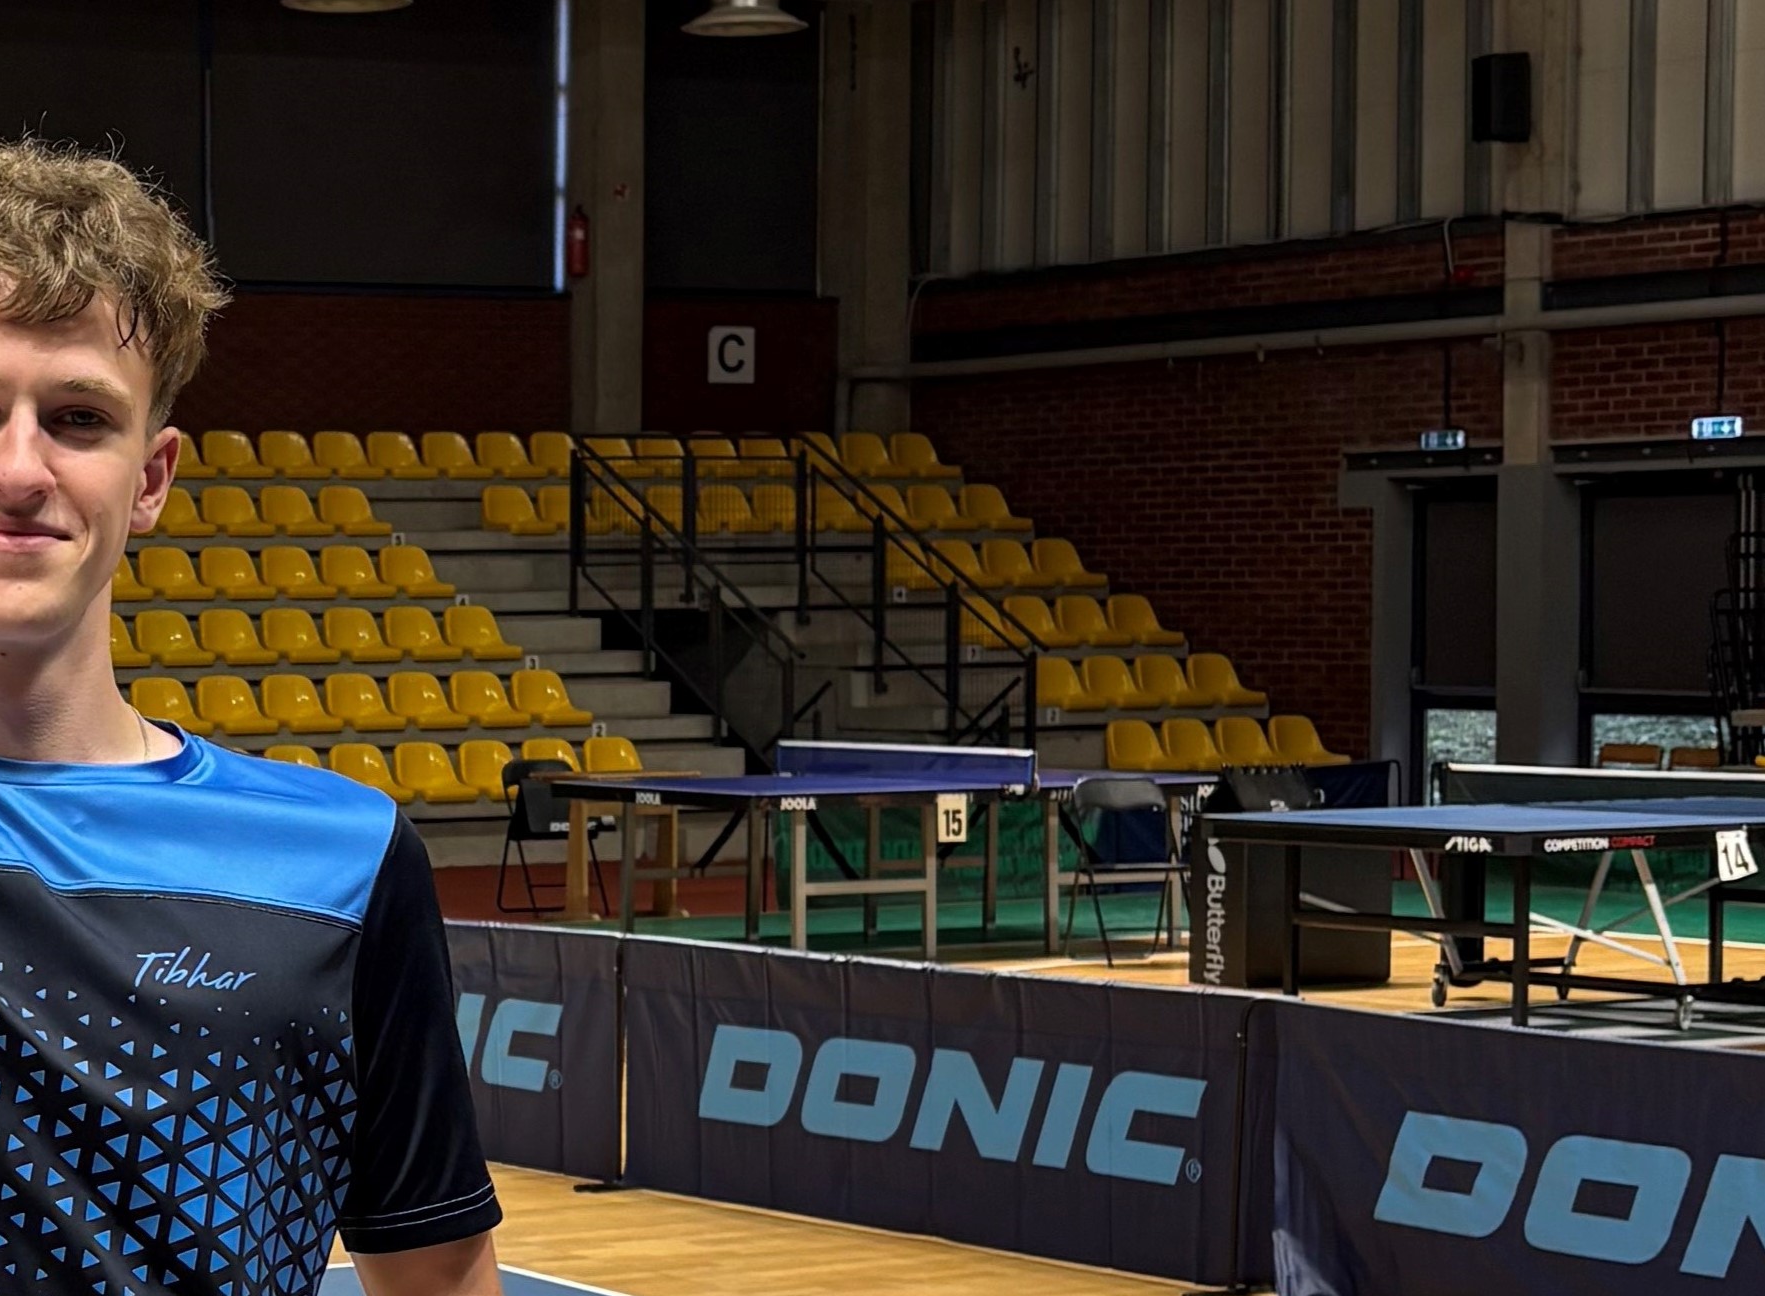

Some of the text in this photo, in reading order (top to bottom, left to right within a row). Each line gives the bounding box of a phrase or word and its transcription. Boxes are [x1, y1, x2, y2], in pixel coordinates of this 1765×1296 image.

[717, 333, 746, 373] C
[636, 792, 661, 804] JOOLA
[780, 797, 816, 811] JOOLA
[943, 809, 962, 837] 15
[1445, 836, 1492, 853] STIGA
[1544, 835, 1656, 853] COMPETITION COMPACT
[1722, 842, 1749, 876] 14
[1204, 874, 1226, 985] Butterfly
[134, 946, 257, 991] Tibhar
[699, 1024, 1208, 1186] DONIC
